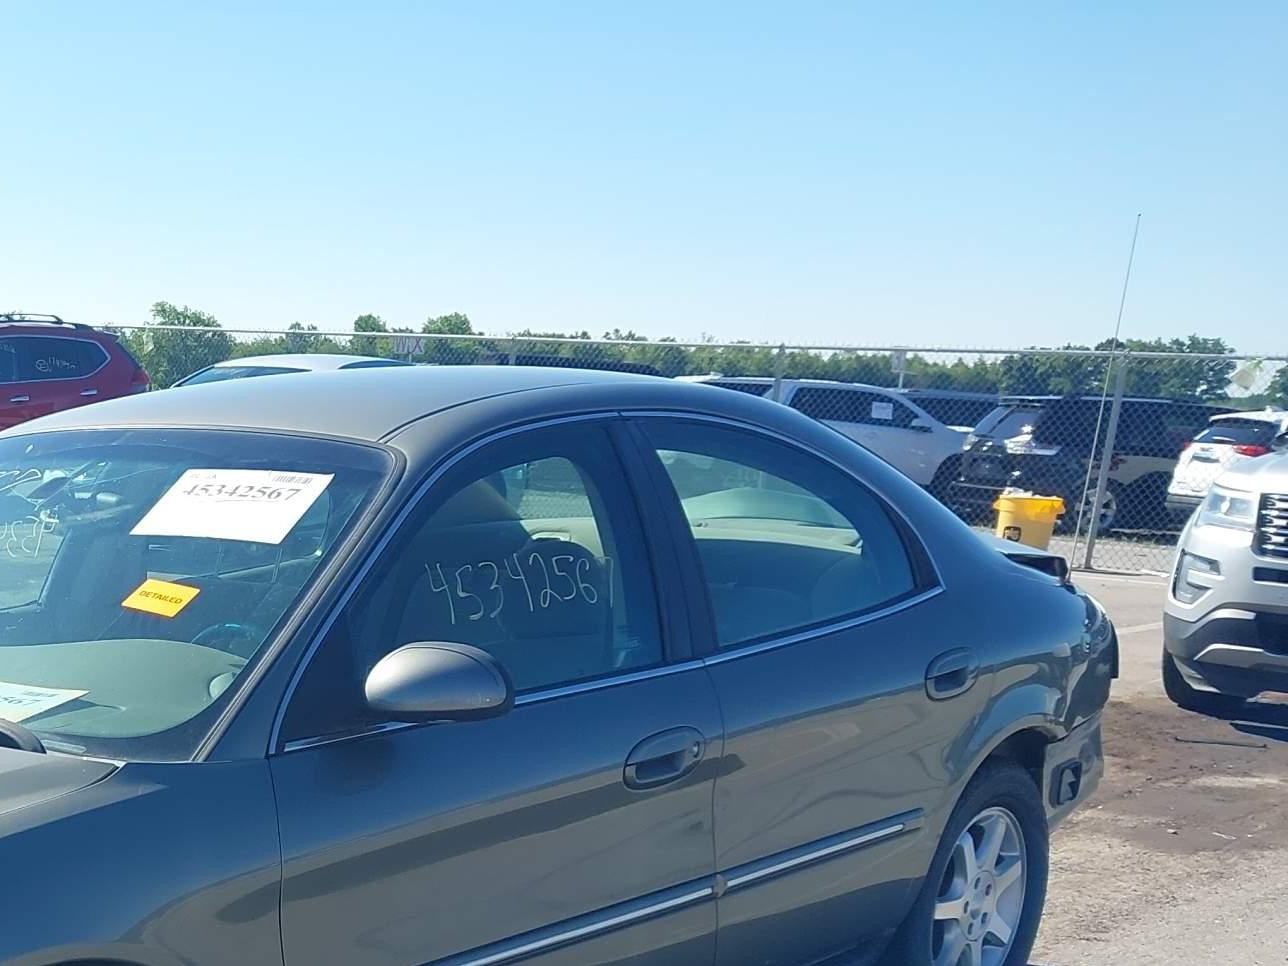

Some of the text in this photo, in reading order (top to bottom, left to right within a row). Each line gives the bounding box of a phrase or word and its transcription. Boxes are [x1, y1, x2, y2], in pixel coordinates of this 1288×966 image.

[183, 484, 302, 501] 45342567
[424, 552, 614, 624] 45342567
[139, 590, 183, 605] DETAILED
